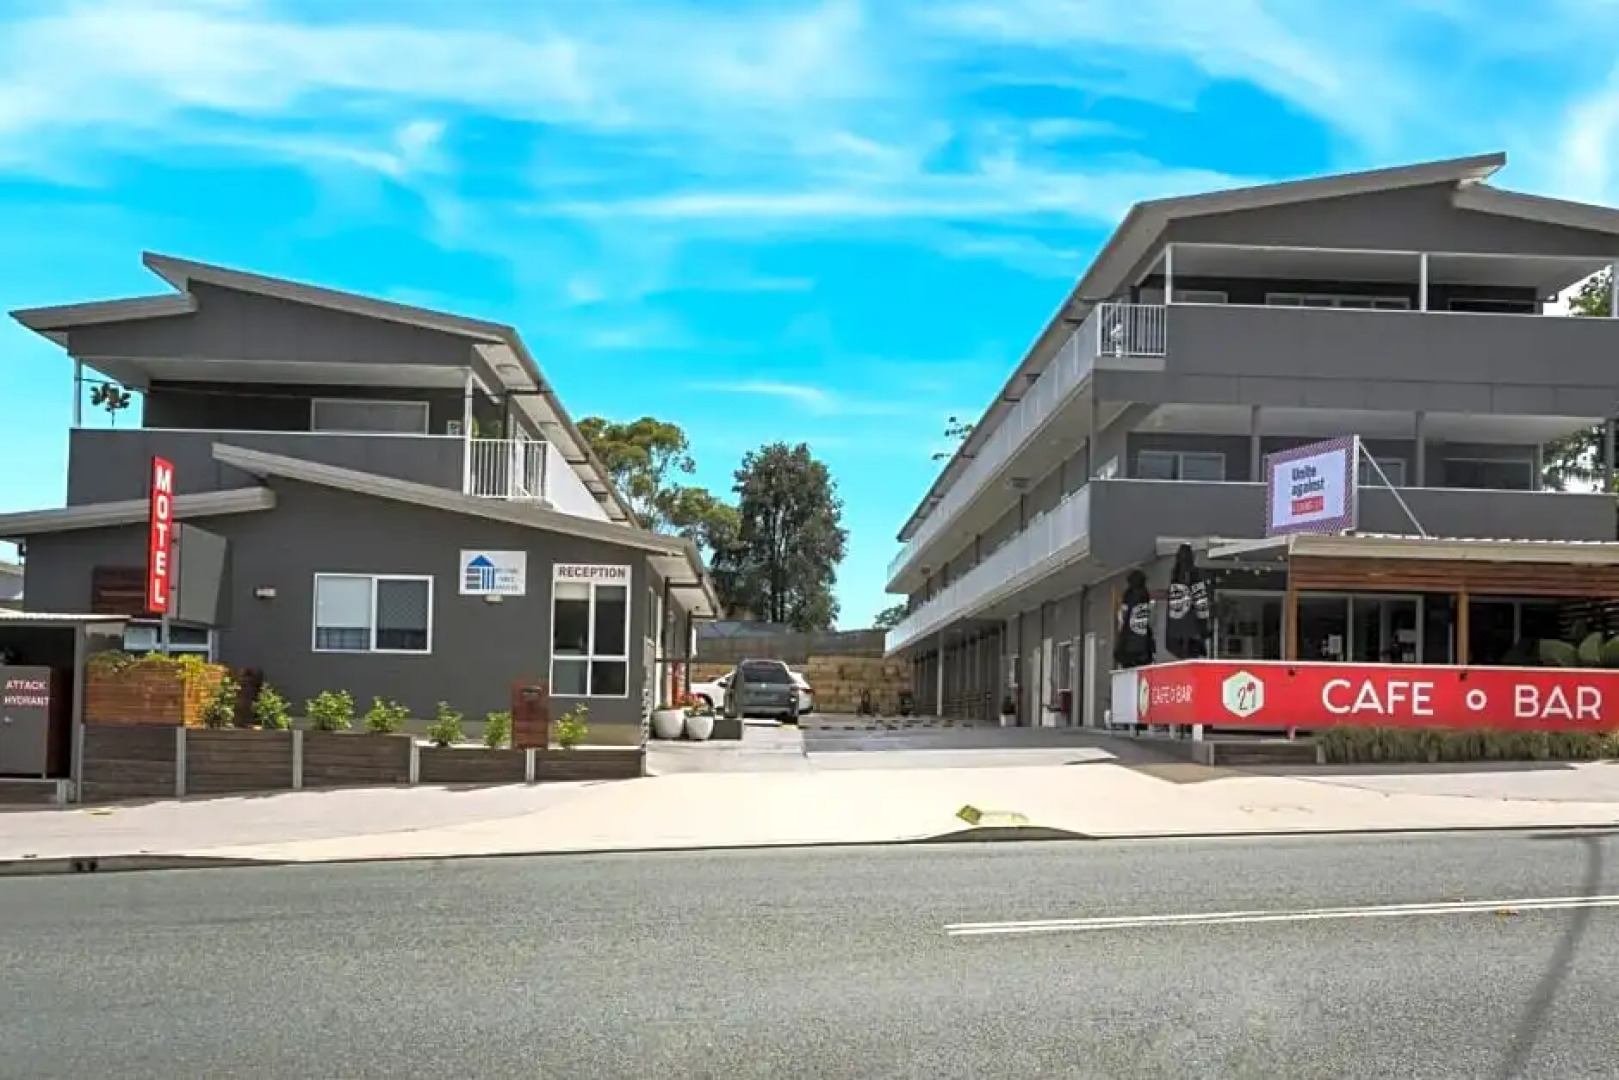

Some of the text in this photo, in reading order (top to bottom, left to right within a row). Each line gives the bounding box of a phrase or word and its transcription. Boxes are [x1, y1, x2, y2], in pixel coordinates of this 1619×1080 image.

[154, 466, 171, 604] MOTEL
[558, 566, 626, 578] RECEPTION
[5, 679, 47, 690] ATTACK
[4, 695, 49, 707] HYDRANT
[1322, 678, 1602, 720] CAFE BAR
